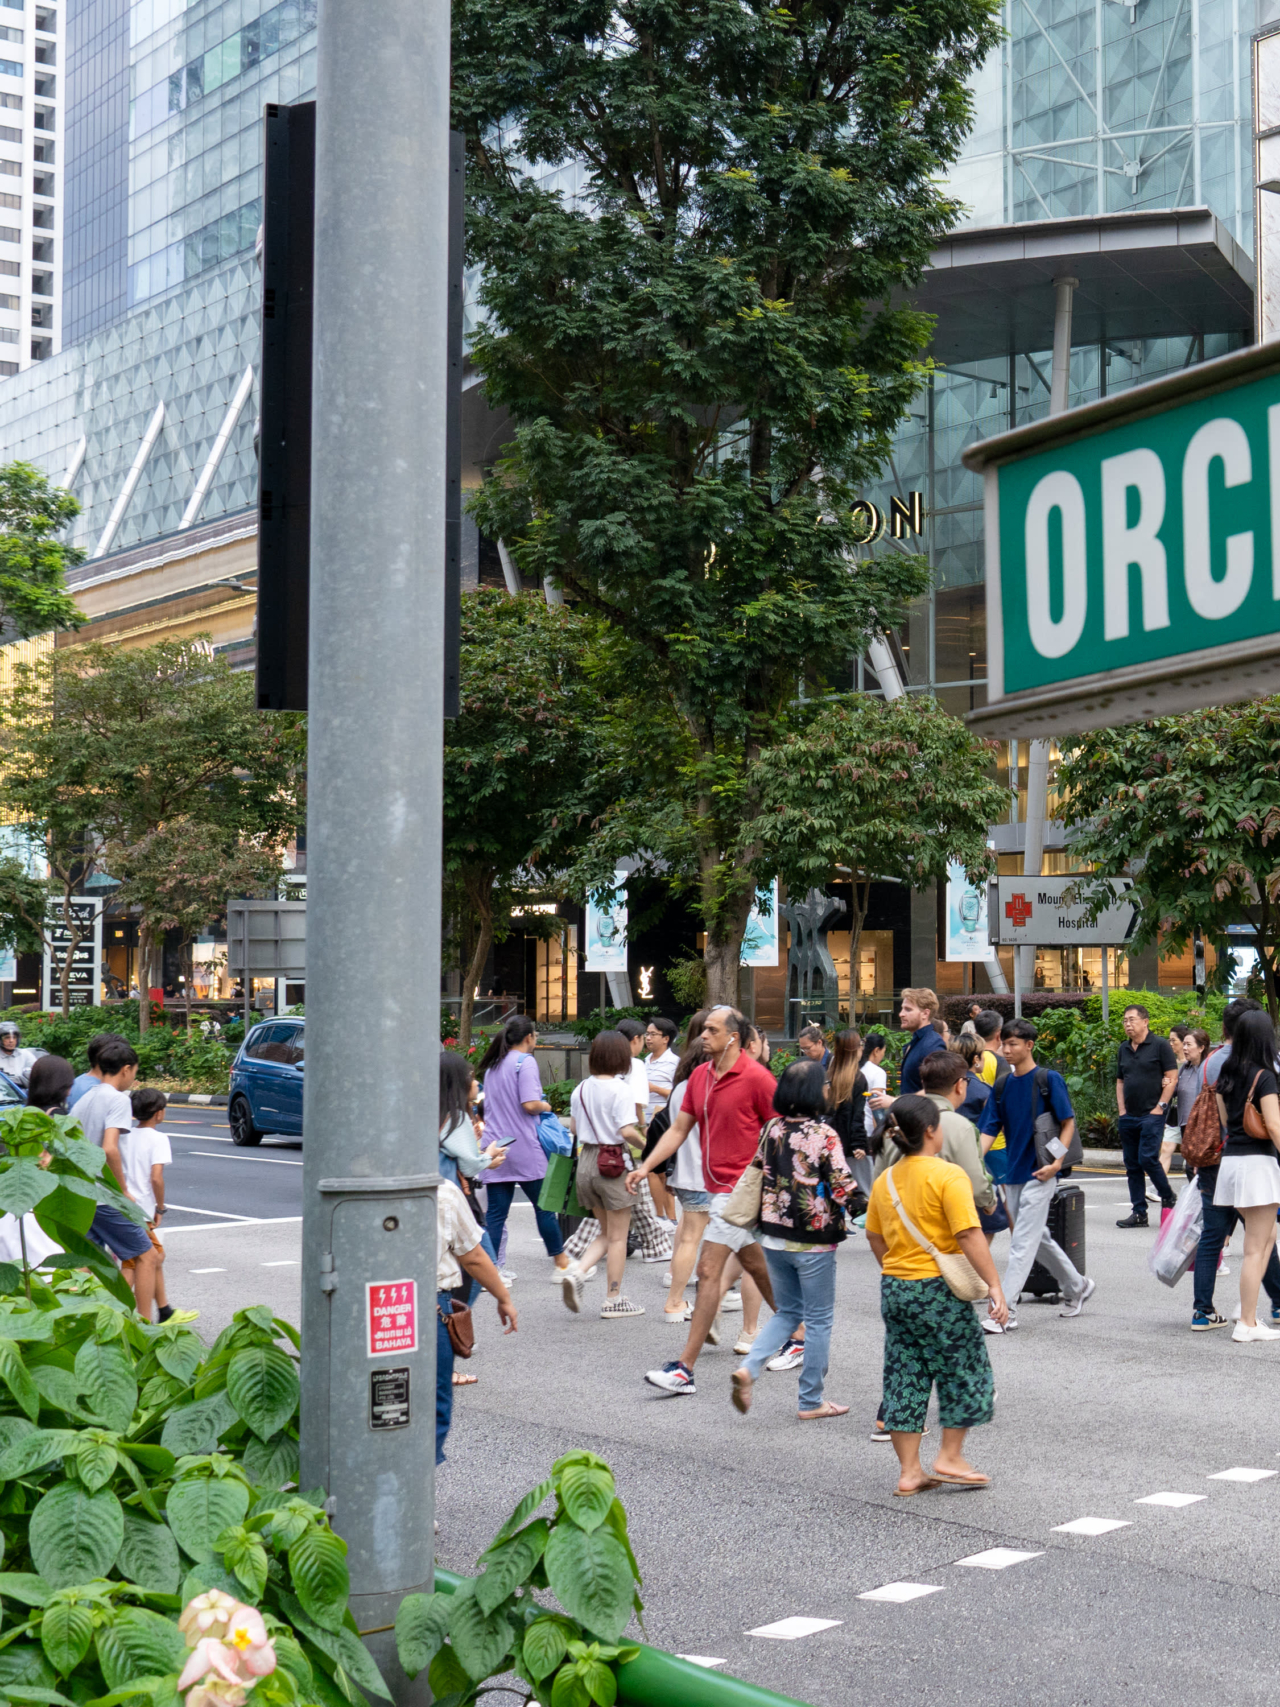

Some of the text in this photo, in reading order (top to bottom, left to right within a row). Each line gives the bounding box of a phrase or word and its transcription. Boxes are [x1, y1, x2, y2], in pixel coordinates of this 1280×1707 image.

[1038, 892, 1067, 905] Moun
[374, 1303, 412, 1317] DANGER
[376, 1338, 412, 1350] BAHAYA
